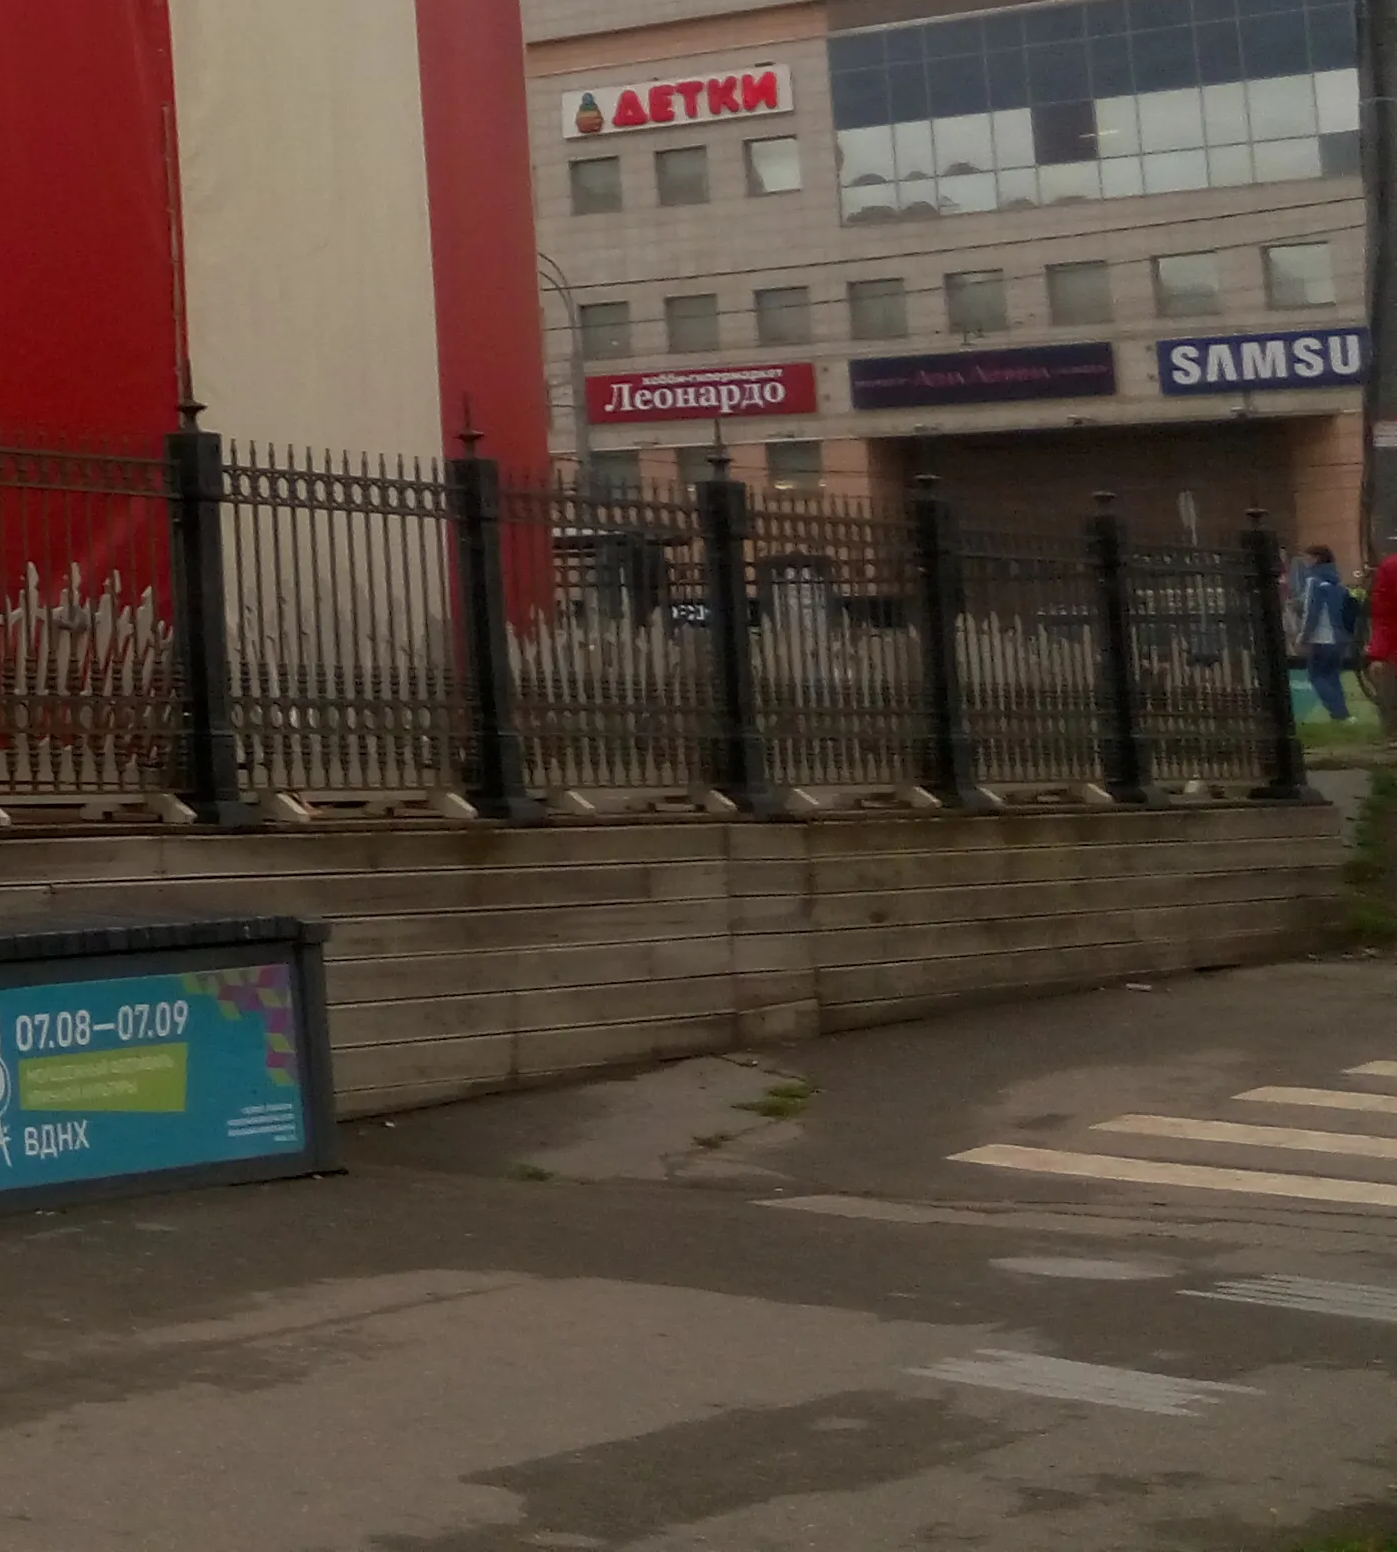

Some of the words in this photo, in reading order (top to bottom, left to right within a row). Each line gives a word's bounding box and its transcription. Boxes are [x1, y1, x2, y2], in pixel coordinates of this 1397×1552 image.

[612, 71, 777, 127] ДЕТКИ
[1171, 335, 1361, 385] SAMSU
[605, 381, 785, 413] Леонардо
[24, 1119, 90, 1159] ВДНХ
